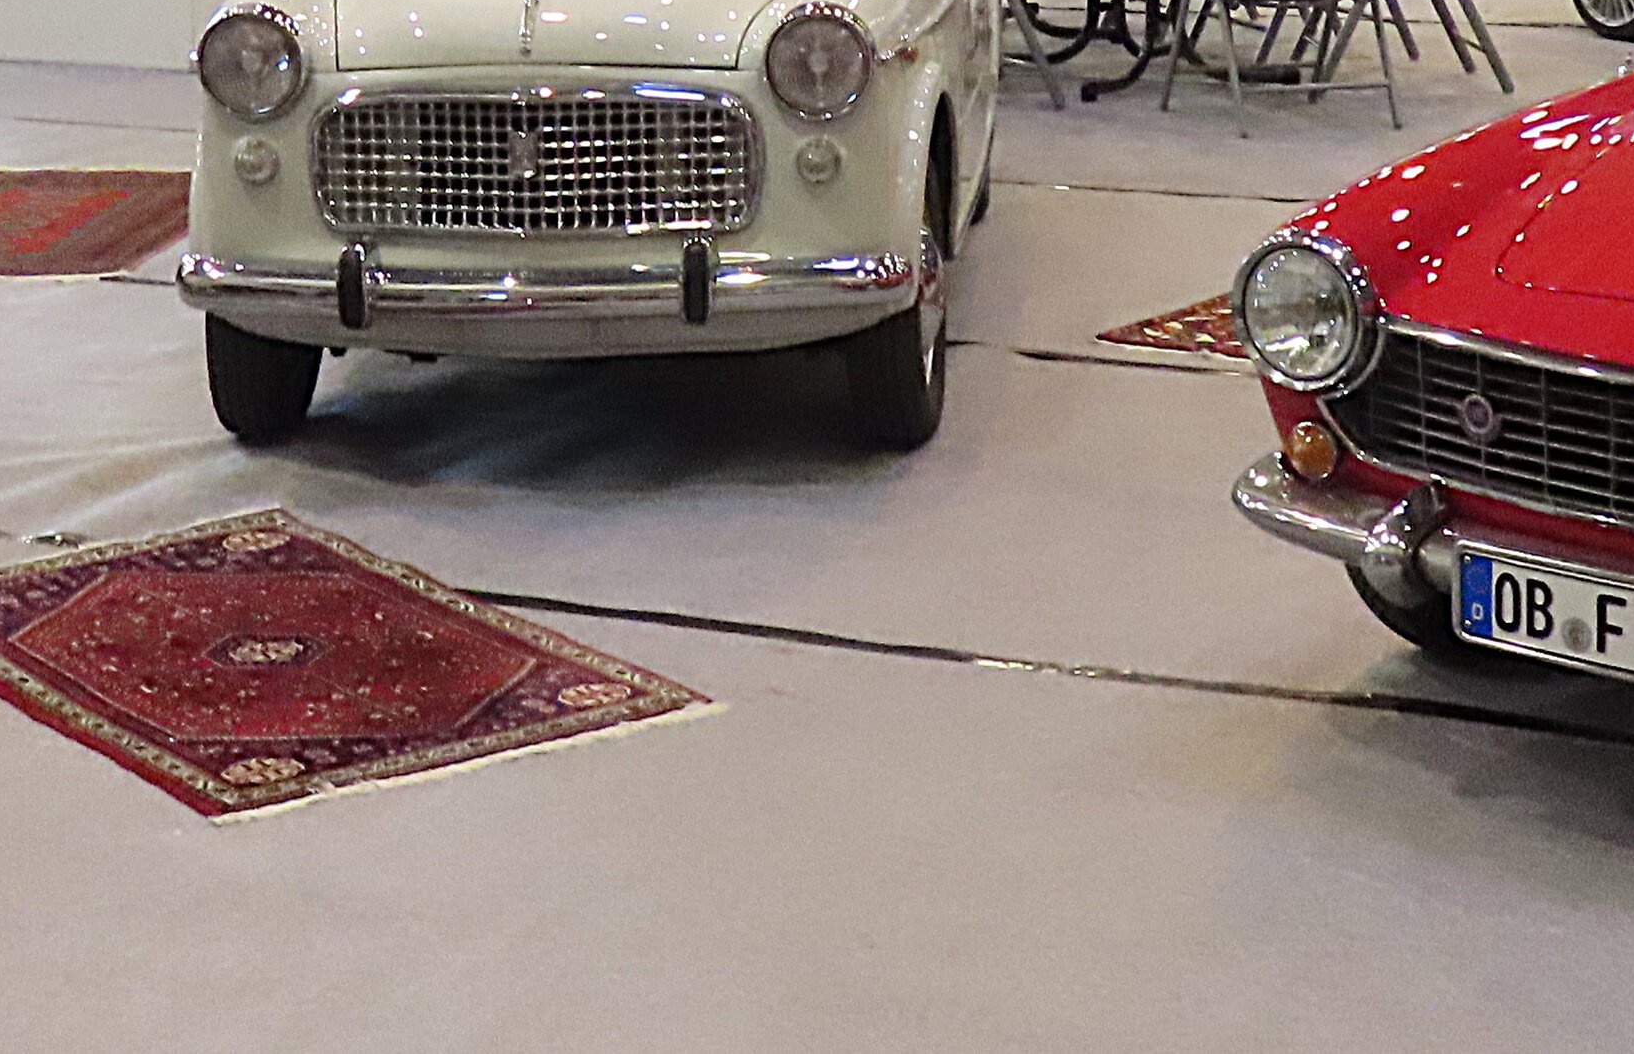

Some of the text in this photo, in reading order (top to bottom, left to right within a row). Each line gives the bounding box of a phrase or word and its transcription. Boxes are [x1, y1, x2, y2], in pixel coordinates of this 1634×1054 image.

[1472, 603, 1484, 621] D
[1494, 572, 1554, 640] OB
[1596, 594, 1627, 654] F
